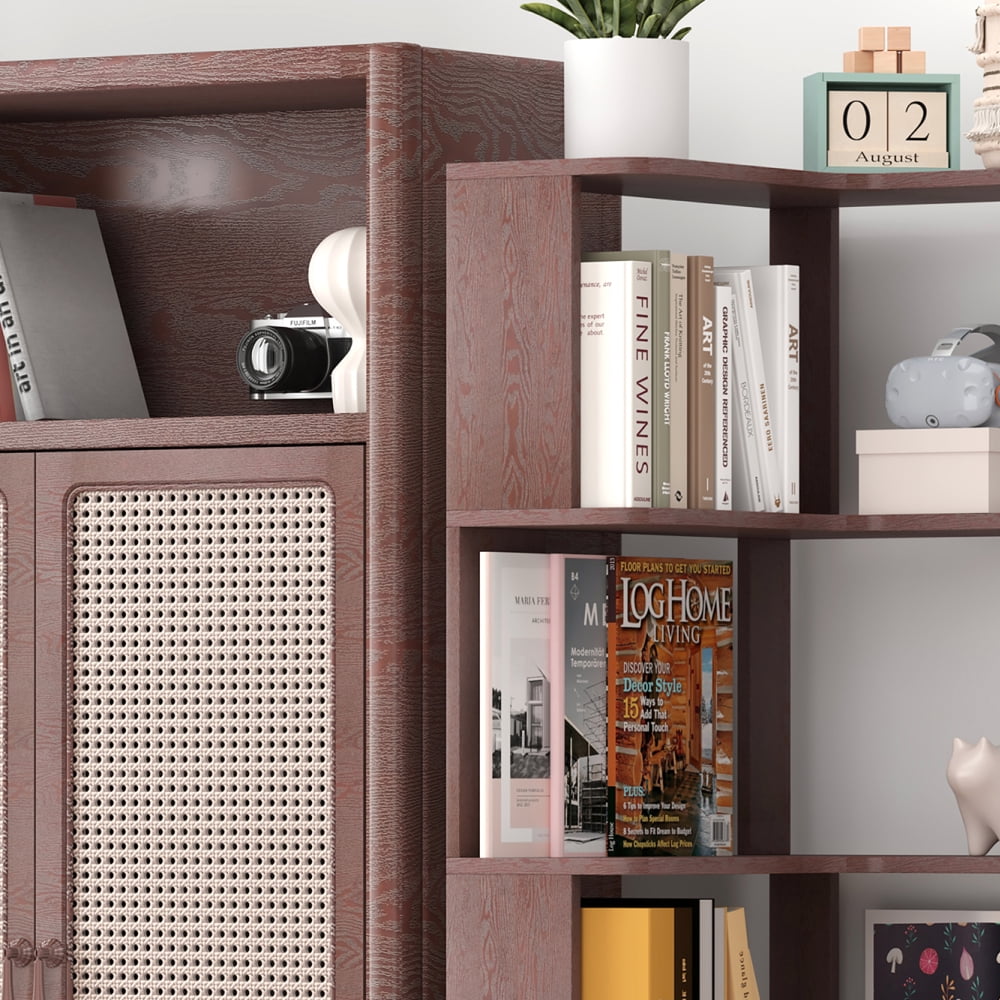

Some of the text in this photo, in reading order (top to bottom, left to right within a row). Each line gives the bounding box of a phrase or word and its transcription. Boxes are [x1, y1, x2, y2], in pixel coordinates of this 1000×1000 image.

[842, 100, 930, 141] 0 2
[855, 151, 920, 166] August
[636, 296, 649, 361] FINE
[702, 315, 713, 356] ART
[788, 324, 799, 363] ART
[13, 361, 31, 393] art
[636, 376, 649, 474] WINES
[760, 383, 773, 452] EERO SAARINEN
[620, 561, 731, 575] FLOOR PLANS TO GET YOU STARTED
[652, 624, 701, 644] LIVING
[623, 661, 671, 674] DISCOVER YOUR
[623, 677, 682, 697] Decor Style
[623, 696, 664, 719] 15 Ways to
[623, 721, 669, 732] Personal Touch
